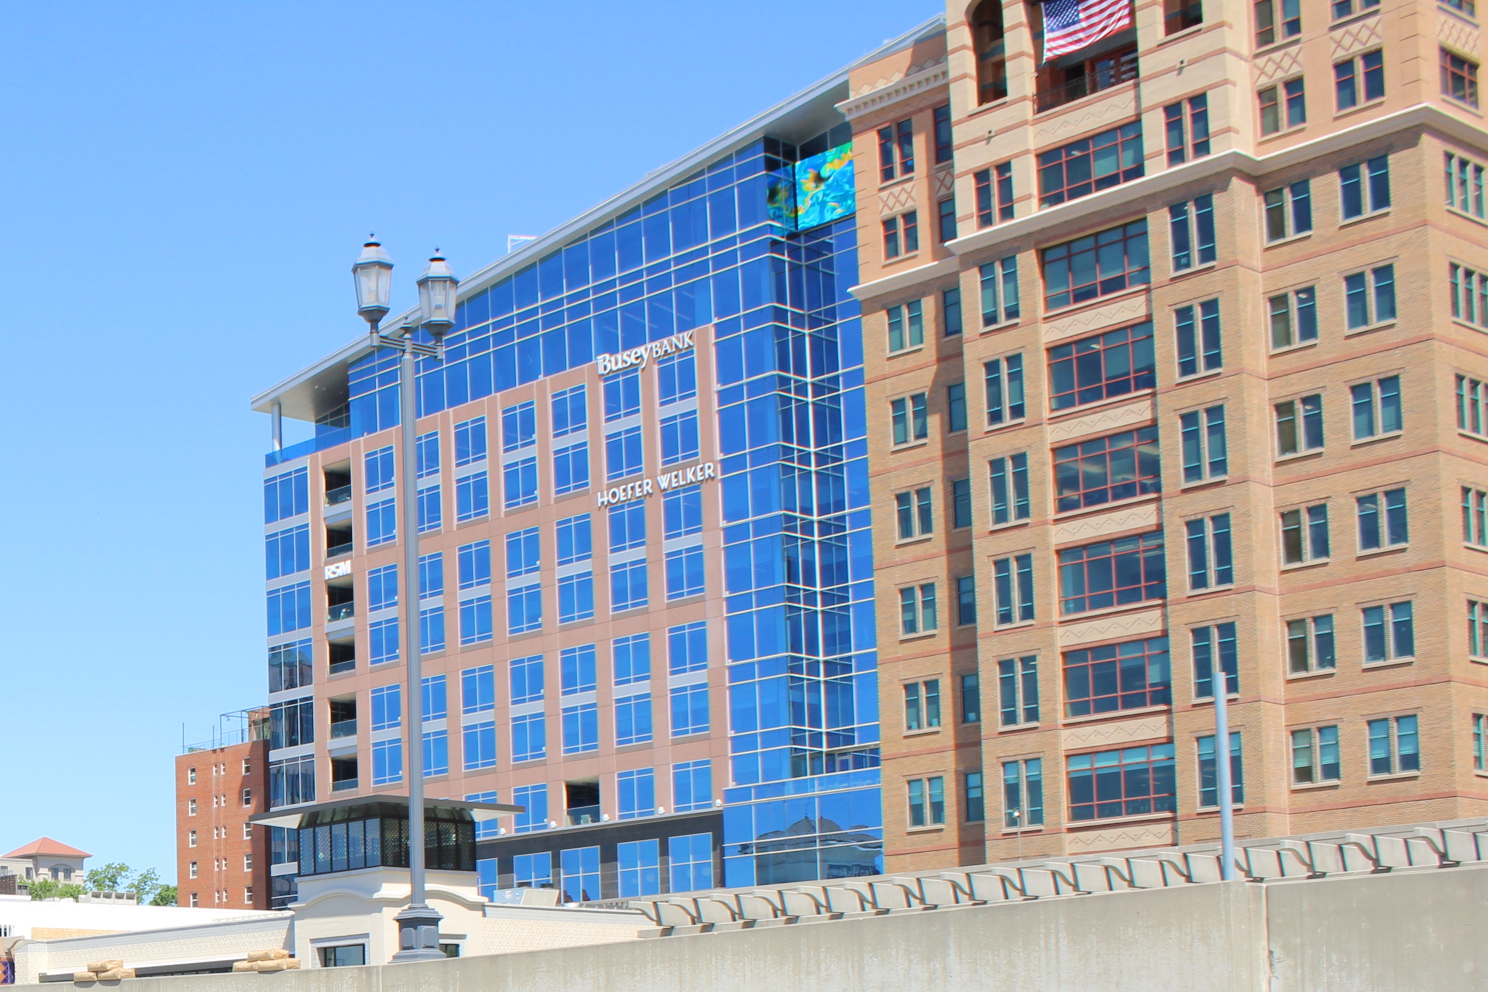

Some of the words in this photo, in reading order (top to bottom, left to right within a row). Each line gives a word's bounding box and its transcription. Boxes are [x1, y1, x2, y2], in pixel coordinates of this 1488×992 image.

[597, 478, 653, 507] HOEFER
[657, 462, 715, 491] WELKER
[324, 559, 351, 580] RSM
